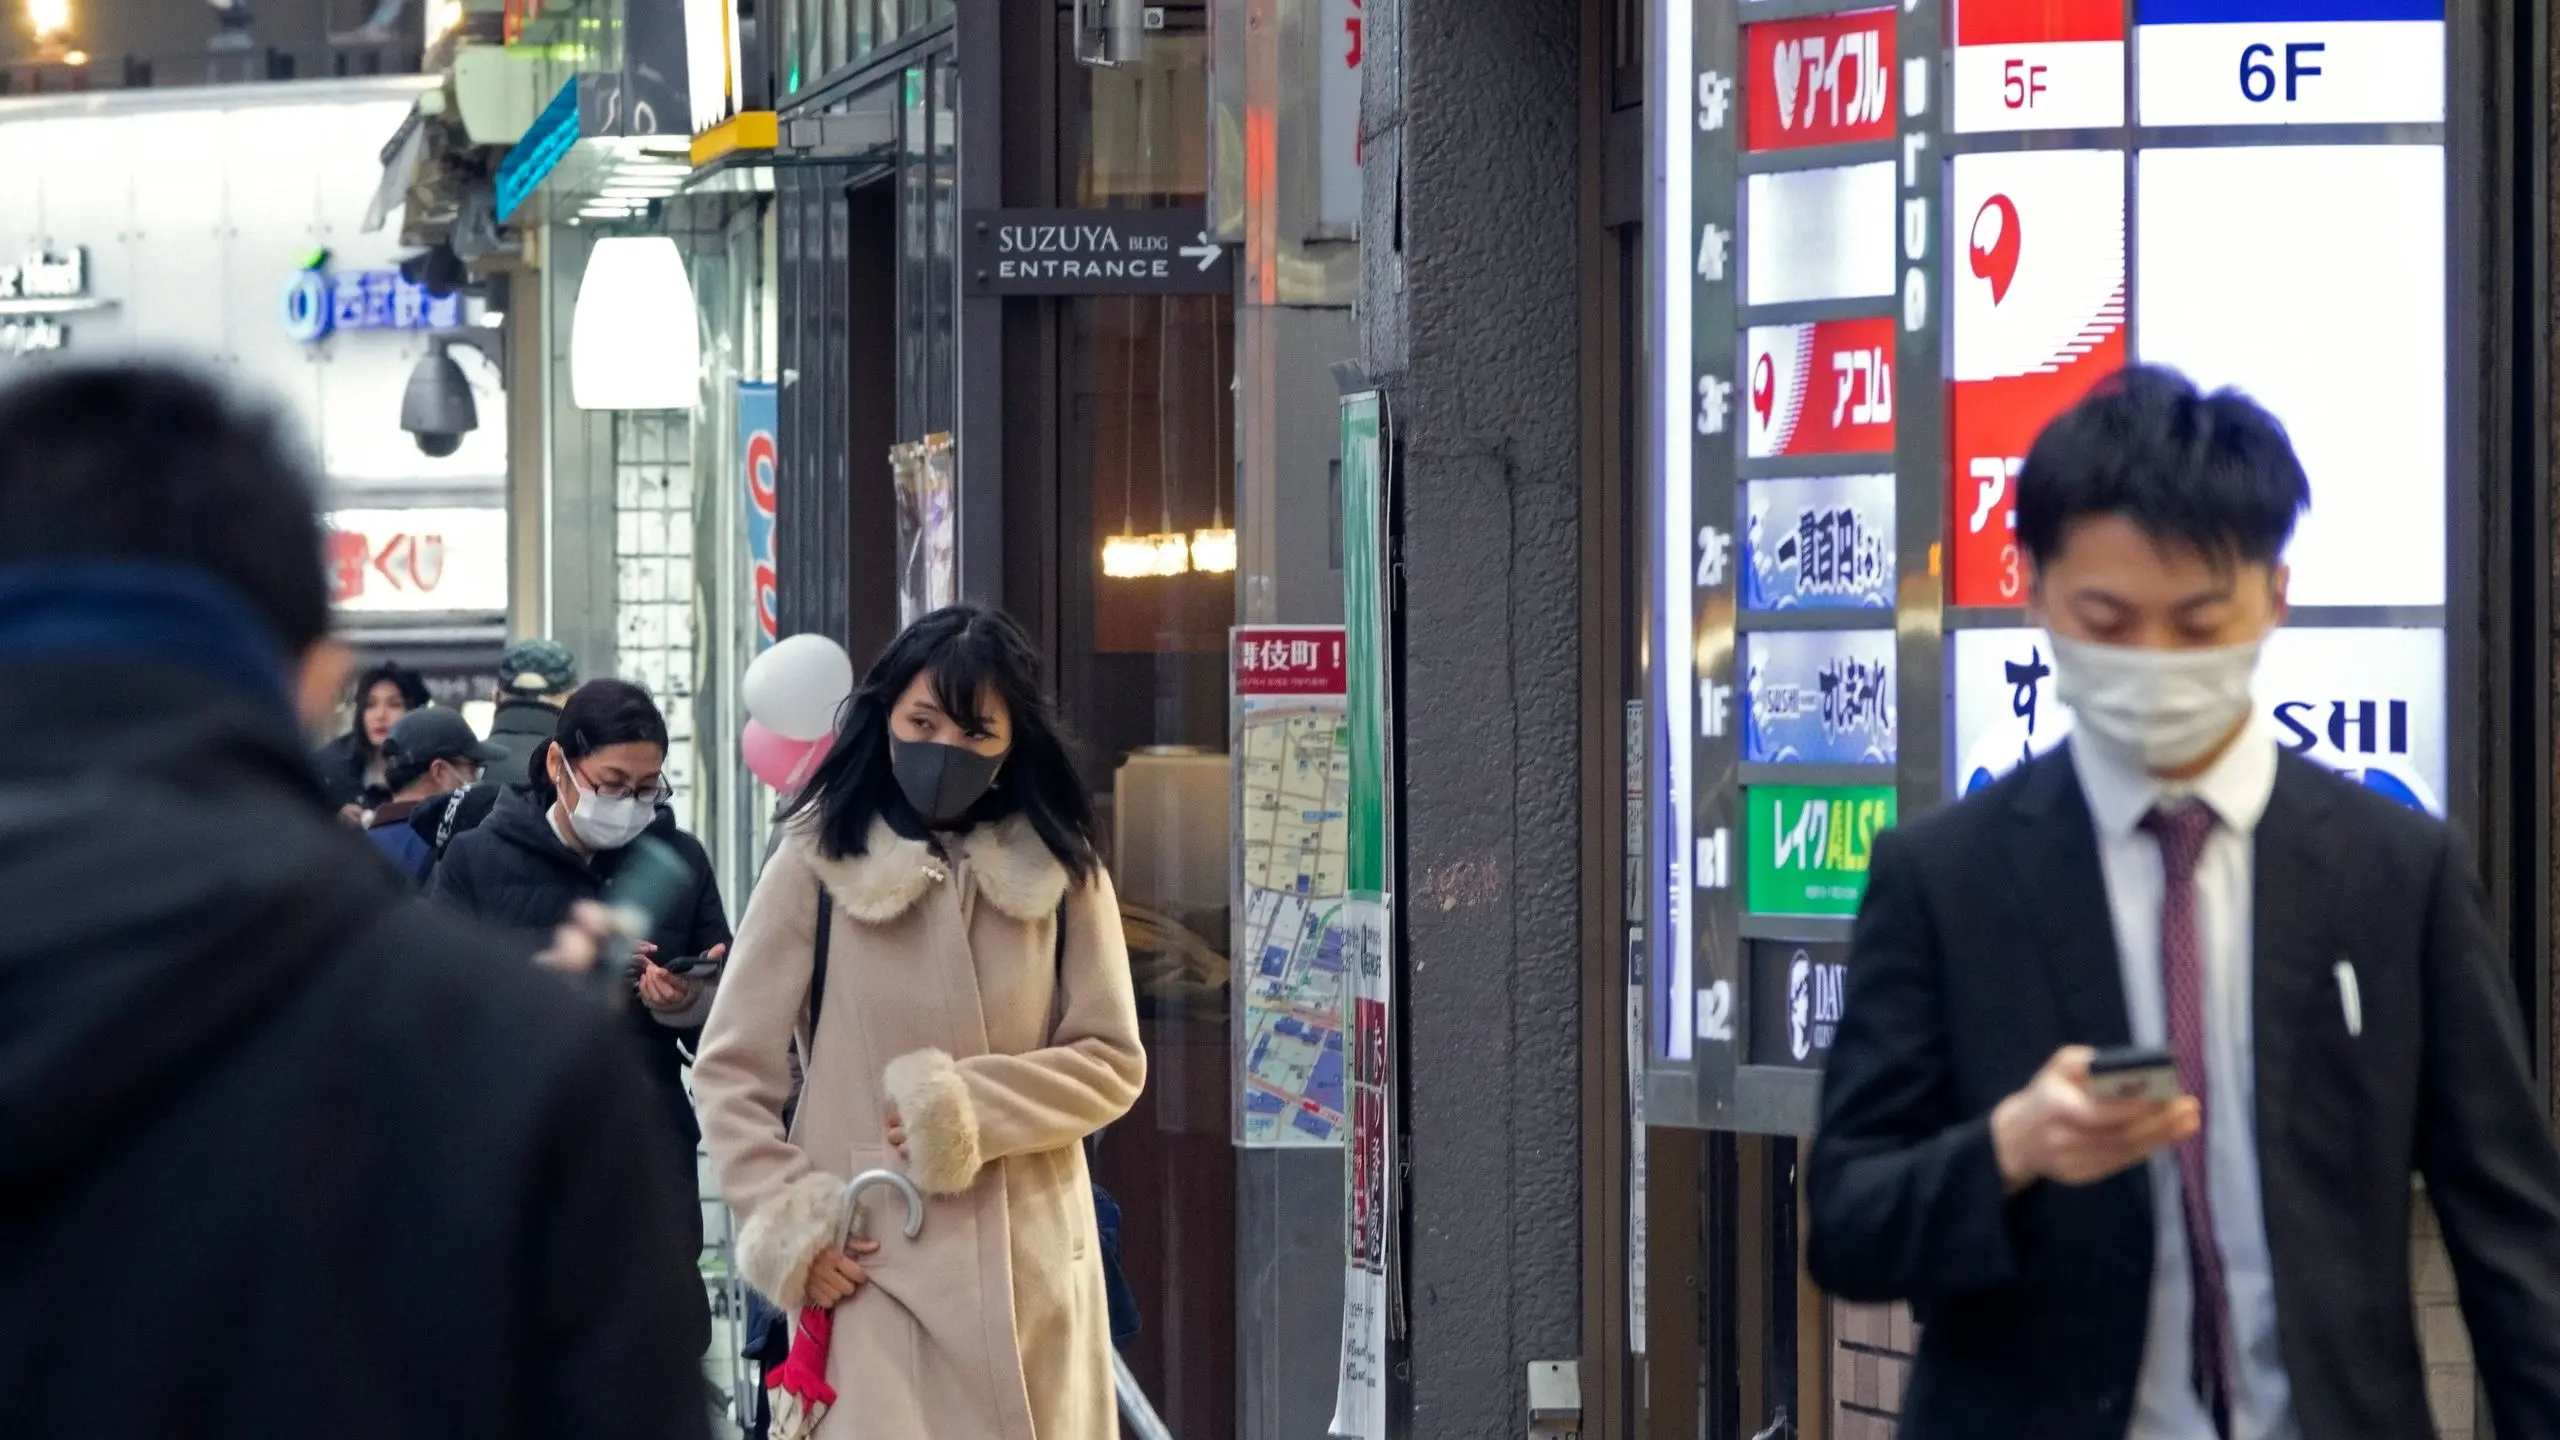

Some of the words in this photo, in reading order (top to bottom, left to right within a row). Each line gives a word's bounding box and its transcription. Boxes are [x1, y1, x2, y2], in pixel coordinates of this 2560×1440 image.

[1698, 71, 1732, 131] 5F
[1801, 30, 1887, 129] アイフル
[2004, 60, 2047, 109] 5F
[2239, 42, 2325, 103] 6F
[1000, 226, 1119, 252] SUZUYA
[1129, 236, 1168, 250] BLDG
[1000, 260, 1168, 277] ENTRANCE
[1697, 223, 1732, 281] 4F
[1697, 374, 1732, 434] 3F
[1832, 346, 1892, 428] アコム
[1697, 525, 1732, 586] 2F
[1700, 677, 1732, 736] 1F
[1767, 688, 1799, 713] SUSHI
[2005, 645, 2051, 765] す
[2273, 699, 2408, 754] SHI
[1697, 827, 1732, 888] B1
[1697, 979, 1732, 1041] B2
